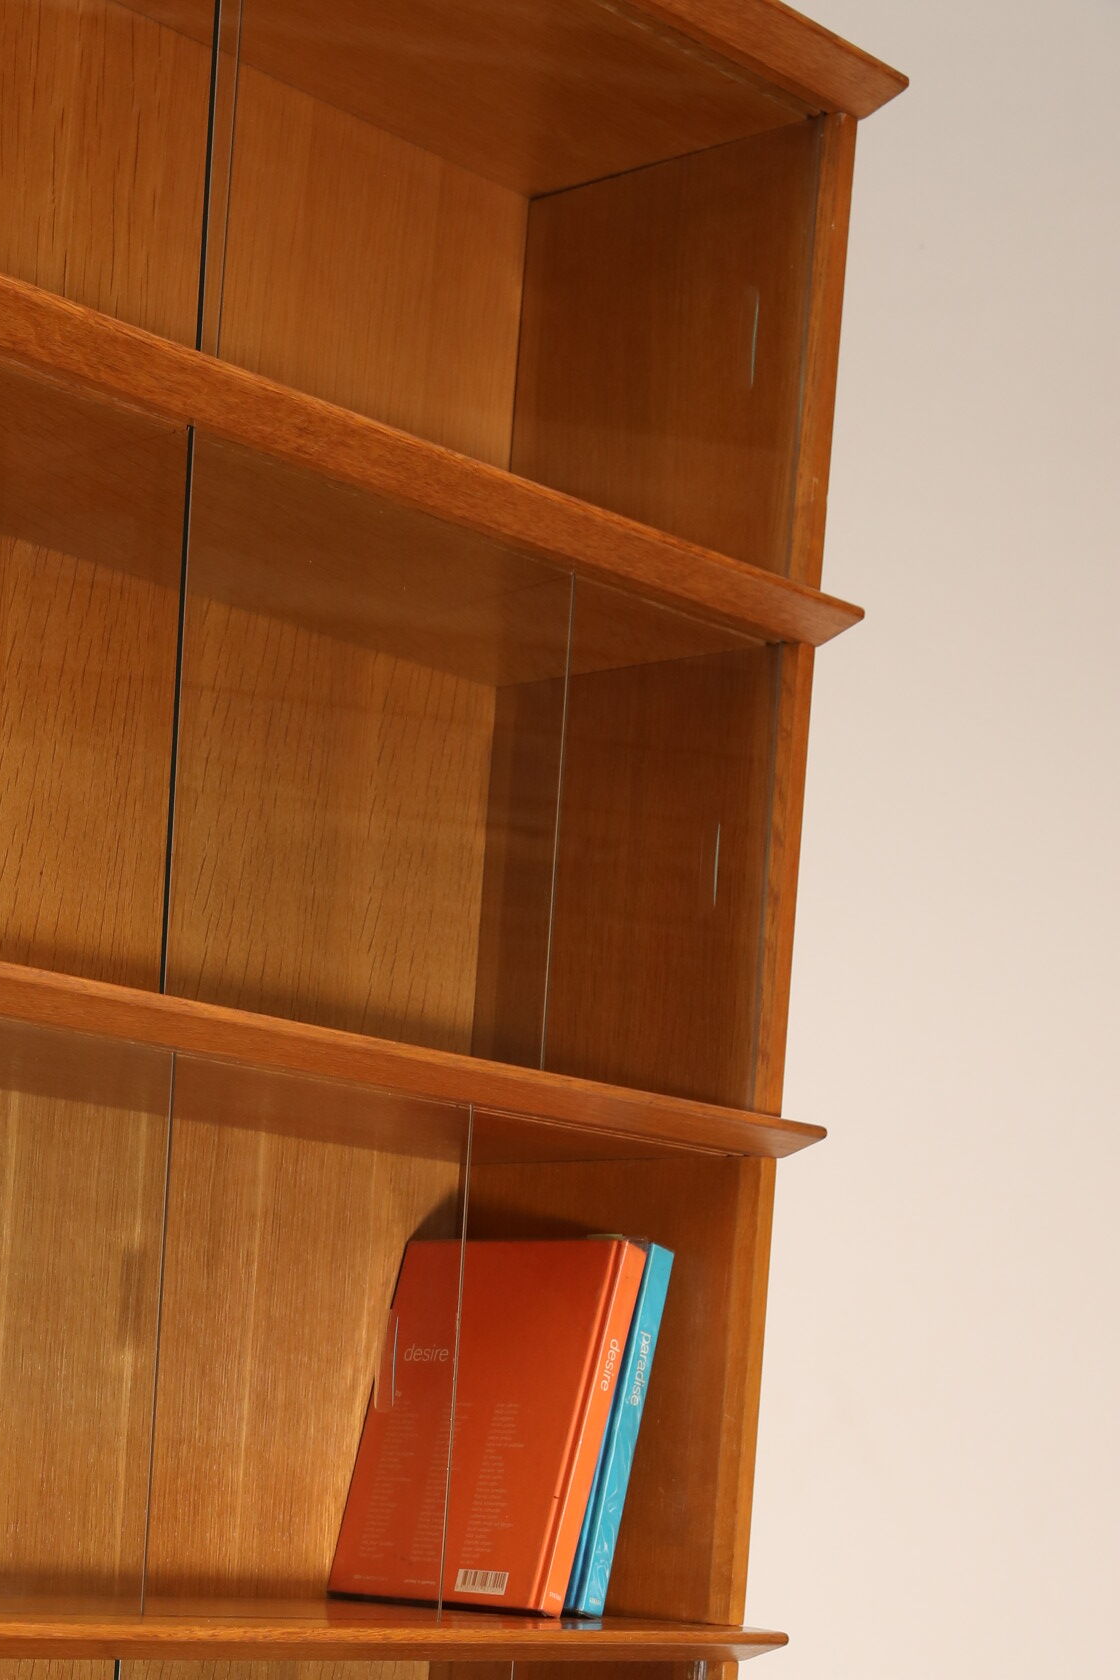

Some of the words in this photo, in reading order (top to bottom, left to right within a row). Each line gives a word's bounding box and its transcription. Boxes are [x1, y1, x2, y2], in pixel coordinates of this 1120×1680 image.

[404, 1343, 449, 1362] desire
[600, 1338, 621, 1391] desire
[630, 1330, 652, 1406] paradise
